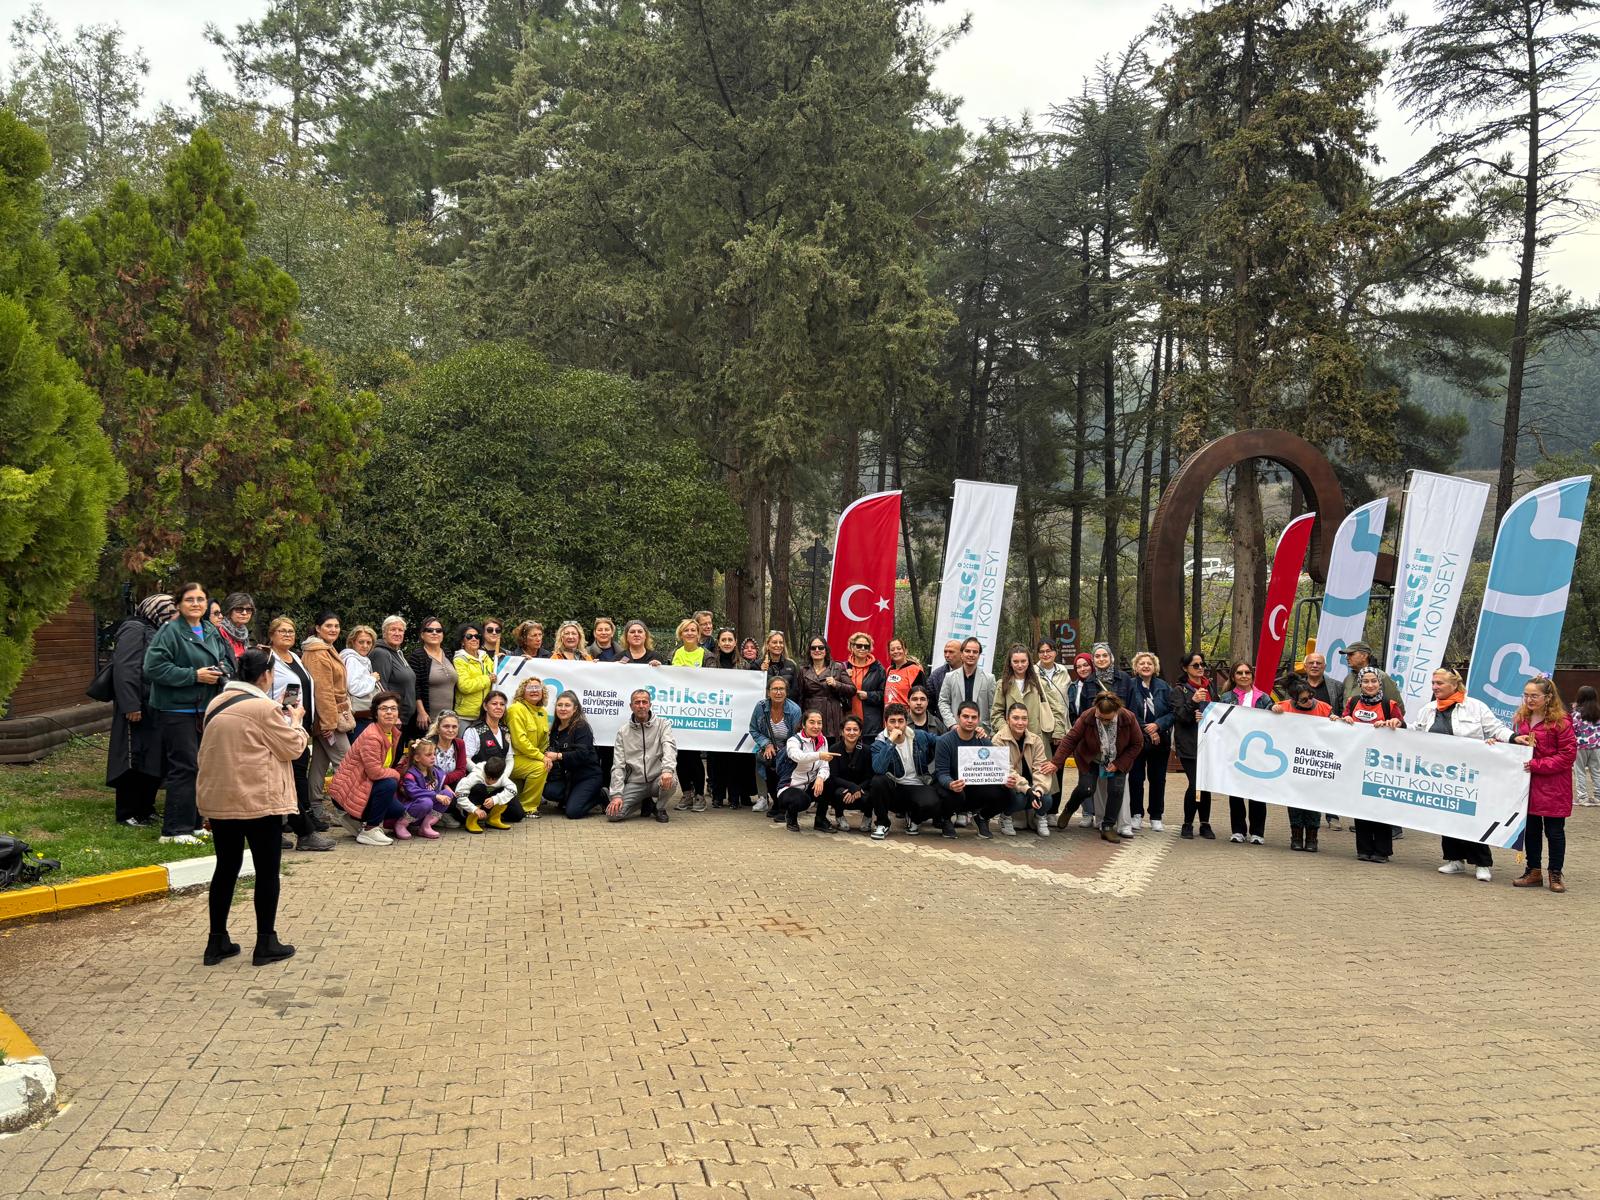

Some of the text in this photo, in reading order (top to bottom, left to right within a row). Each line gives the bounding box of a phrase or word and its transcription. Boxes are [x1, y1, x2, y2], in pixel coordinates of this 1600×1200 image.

[1407, 643, 1432, 698] KENT
[583, 689, 618, 698] BALIKESİR
[582, 697, 625, 708] BÜYÜKŞEHİR
[582, 706, 619, 716] BELEDİYESİ
[652, 705, 677, 715] ENT
[685, 718, 719, 728] MECLİSİ
[1295, 747, 1334, 760] BALIKESİR
[1294, 755, 1342, 771] BÜYÜKŞEHİR
[1364, 748, 1480, 784] Balıkesir
[1292, 765, 1336, 779] BELEDİYESİ
[1363, 770, 1405, 786] KENT
[1378, 787, 1460, 811] ÇEVRE MECLİSİ
